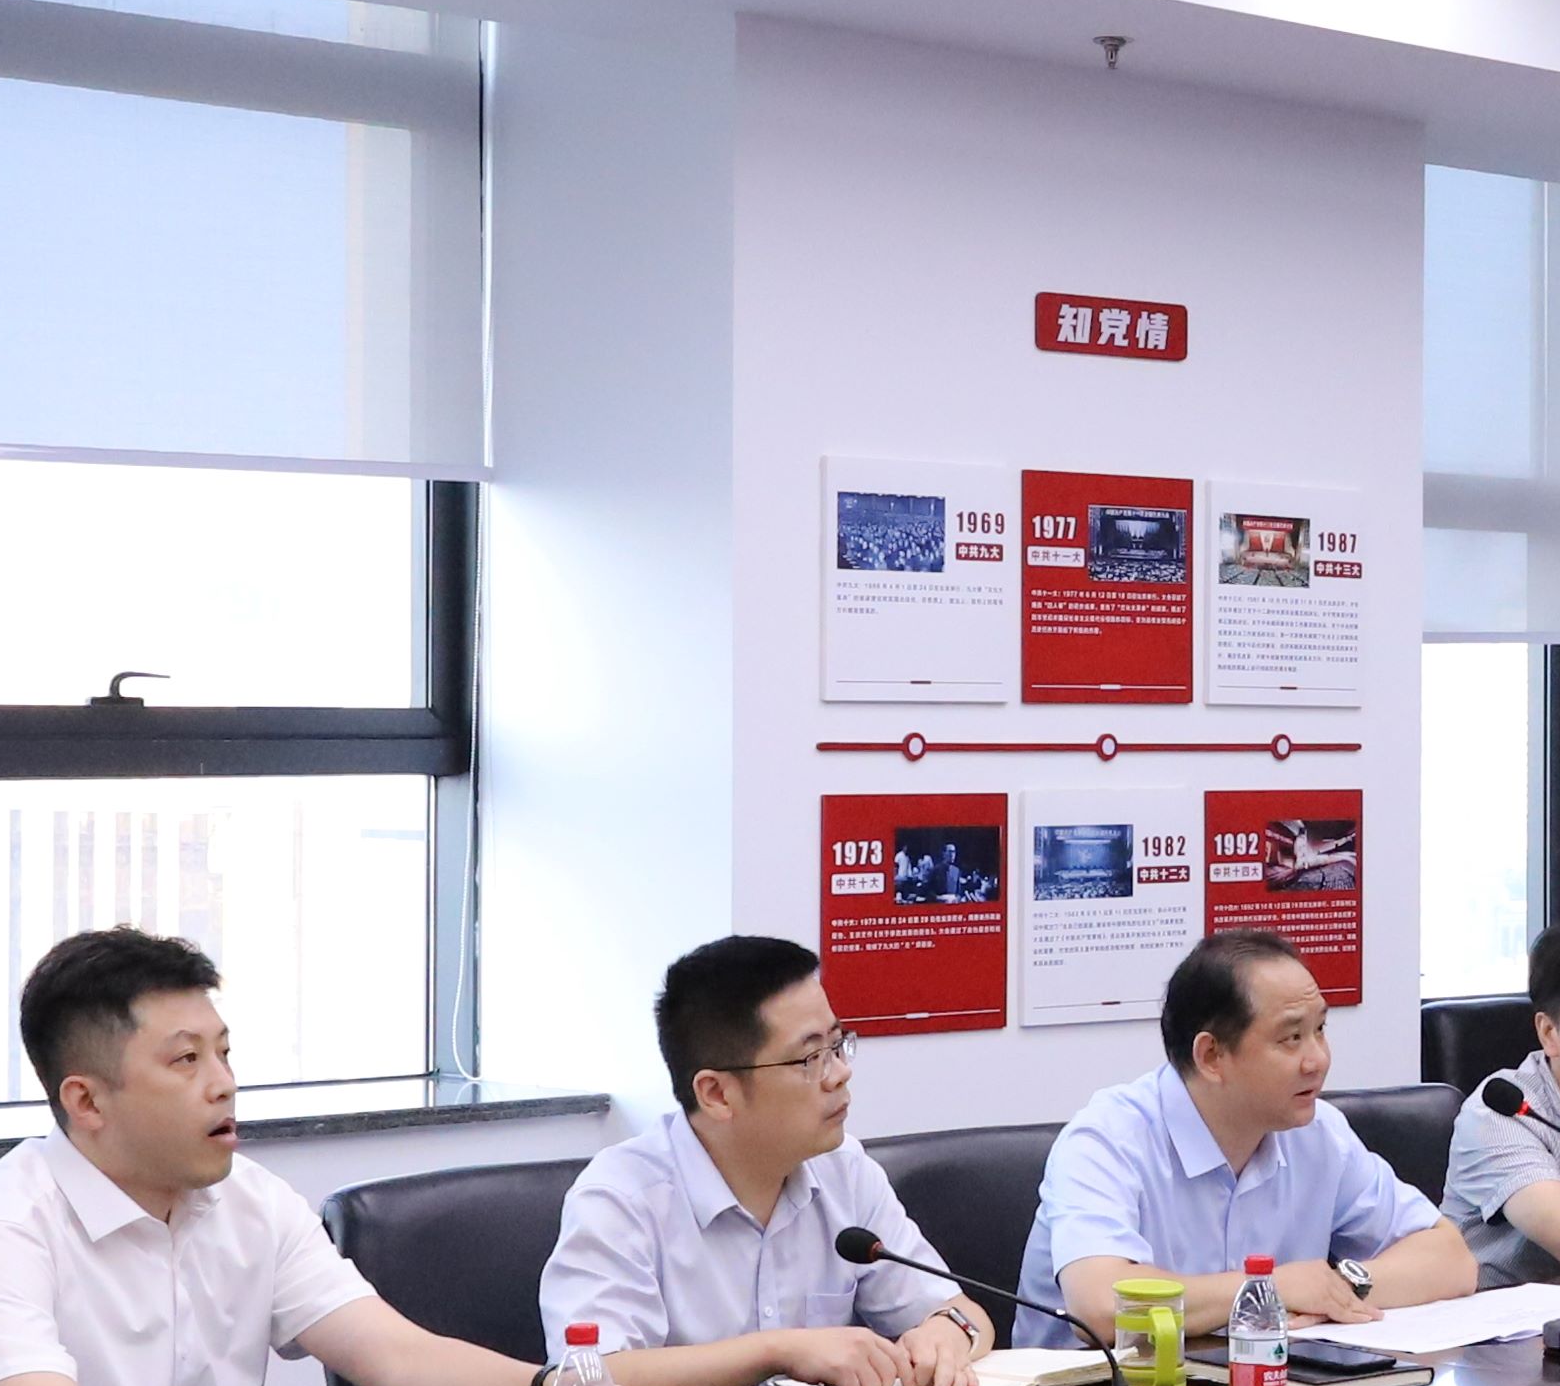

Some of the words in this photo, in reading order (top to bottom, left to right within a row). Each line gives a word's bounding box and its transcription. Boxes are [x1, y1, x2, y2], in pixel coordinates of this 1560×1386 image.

[1056, 303, 1170, 351] 知党情
[956, 511, 1005, 535] 1969
[1032, 515, 1076, 540] 1977
[958, 545, 1000, 559] 中共九大
[1318, 532, 1357, 553] 1987
[1031, 550, 1081, 562] 中共十一大
[1316, 563, 1361, 576] 中共十三大
[832, 840, 883, 866] 1973
[1142, 836, 1186, 857] 1982
[1214, 833, 1259, 856] 1992
[836, 876, 880, 889] 中共十大
[1140, 868, 1188, 881] 中共十二大
[1213, 866, 1260, 878] 中共十四大
